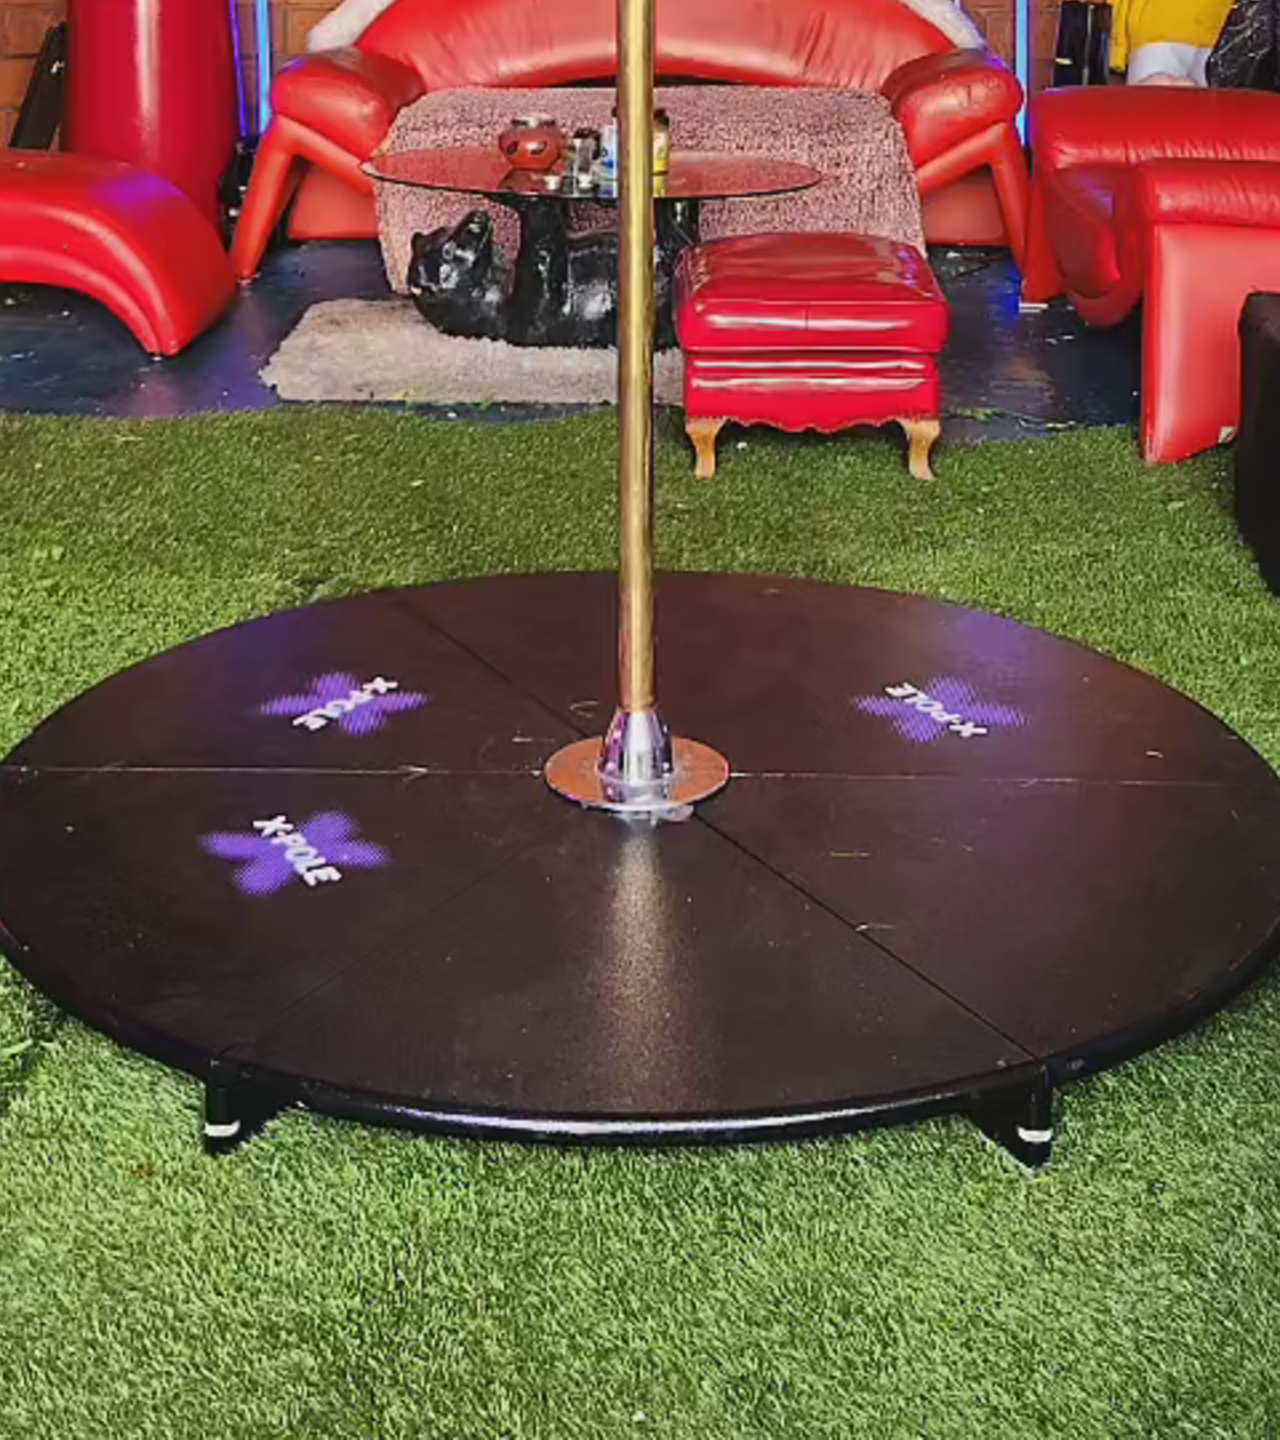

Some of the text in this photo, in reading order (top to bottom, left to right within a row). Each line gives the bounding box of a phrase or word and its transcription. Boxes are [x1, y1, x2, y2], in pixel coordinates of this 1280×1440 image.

[291, 676, 399, 731] X-POLE
[884, 681, 988, 738] X-POLE
[252, 814, 343, 887] X-POLE
